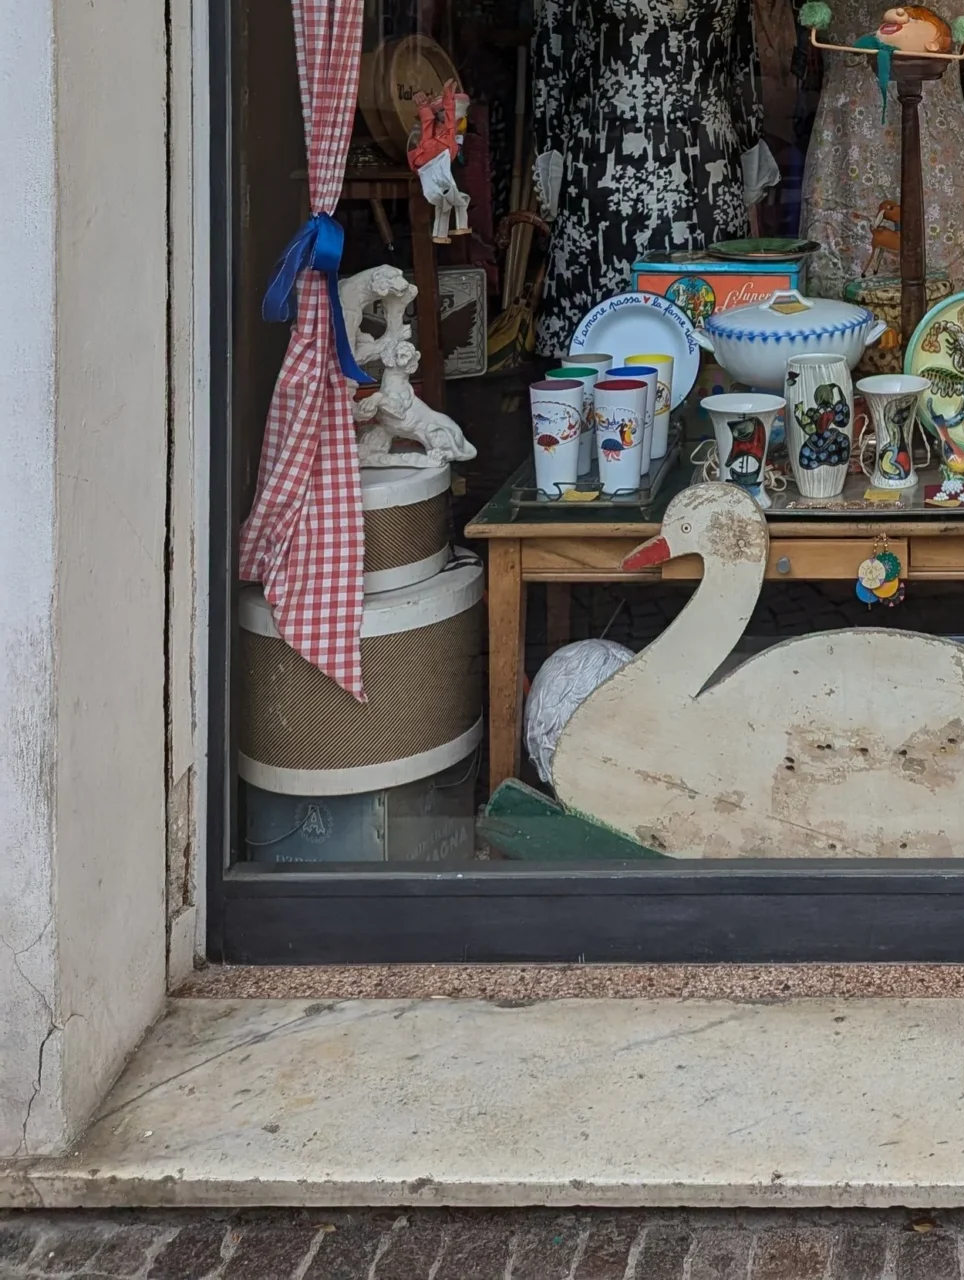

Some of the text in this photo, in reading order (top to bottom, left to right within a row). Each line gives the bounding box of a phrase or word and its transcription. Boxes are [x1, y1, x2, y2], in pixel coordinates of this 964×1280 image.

[608, 295, 642, 312] passa
[651, 296, 663, 309] la
[662, 303, 686, 329] fame
